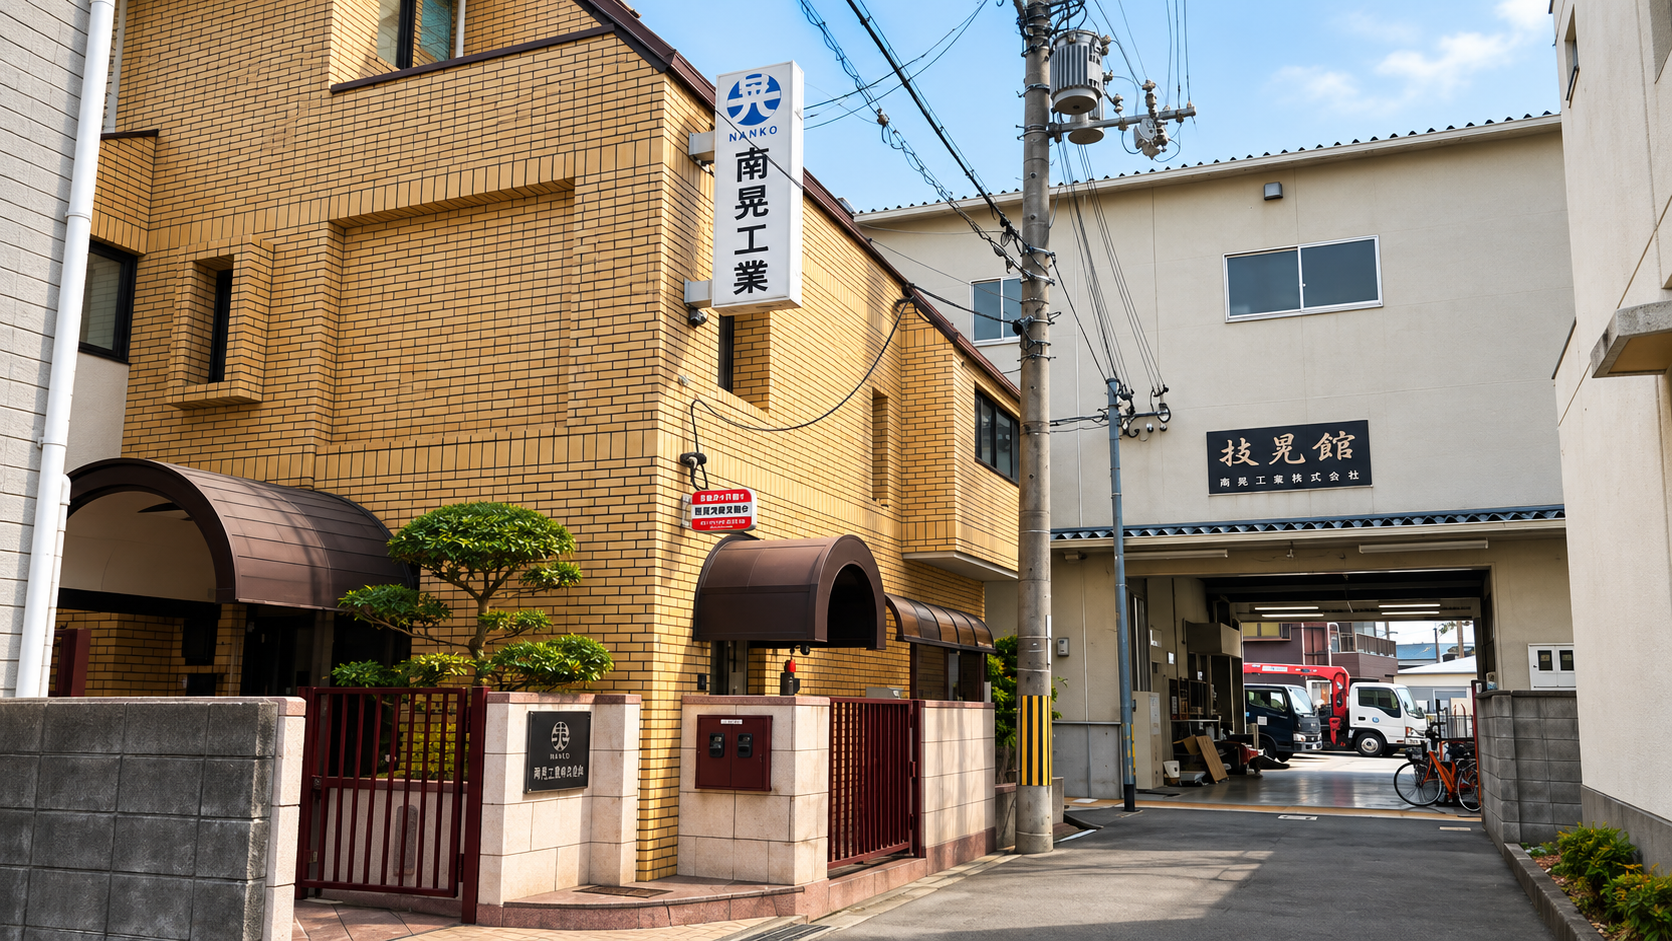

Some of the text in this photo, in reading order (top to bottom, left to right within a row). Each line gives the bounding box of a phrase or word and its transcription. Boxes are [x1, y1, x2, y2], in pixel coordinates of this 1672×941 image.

[728, 125, 778, 142] NANKO
[733, 147, 770, 296] 南晃工業
[1218, 430, 1356, 467] 技晃館
